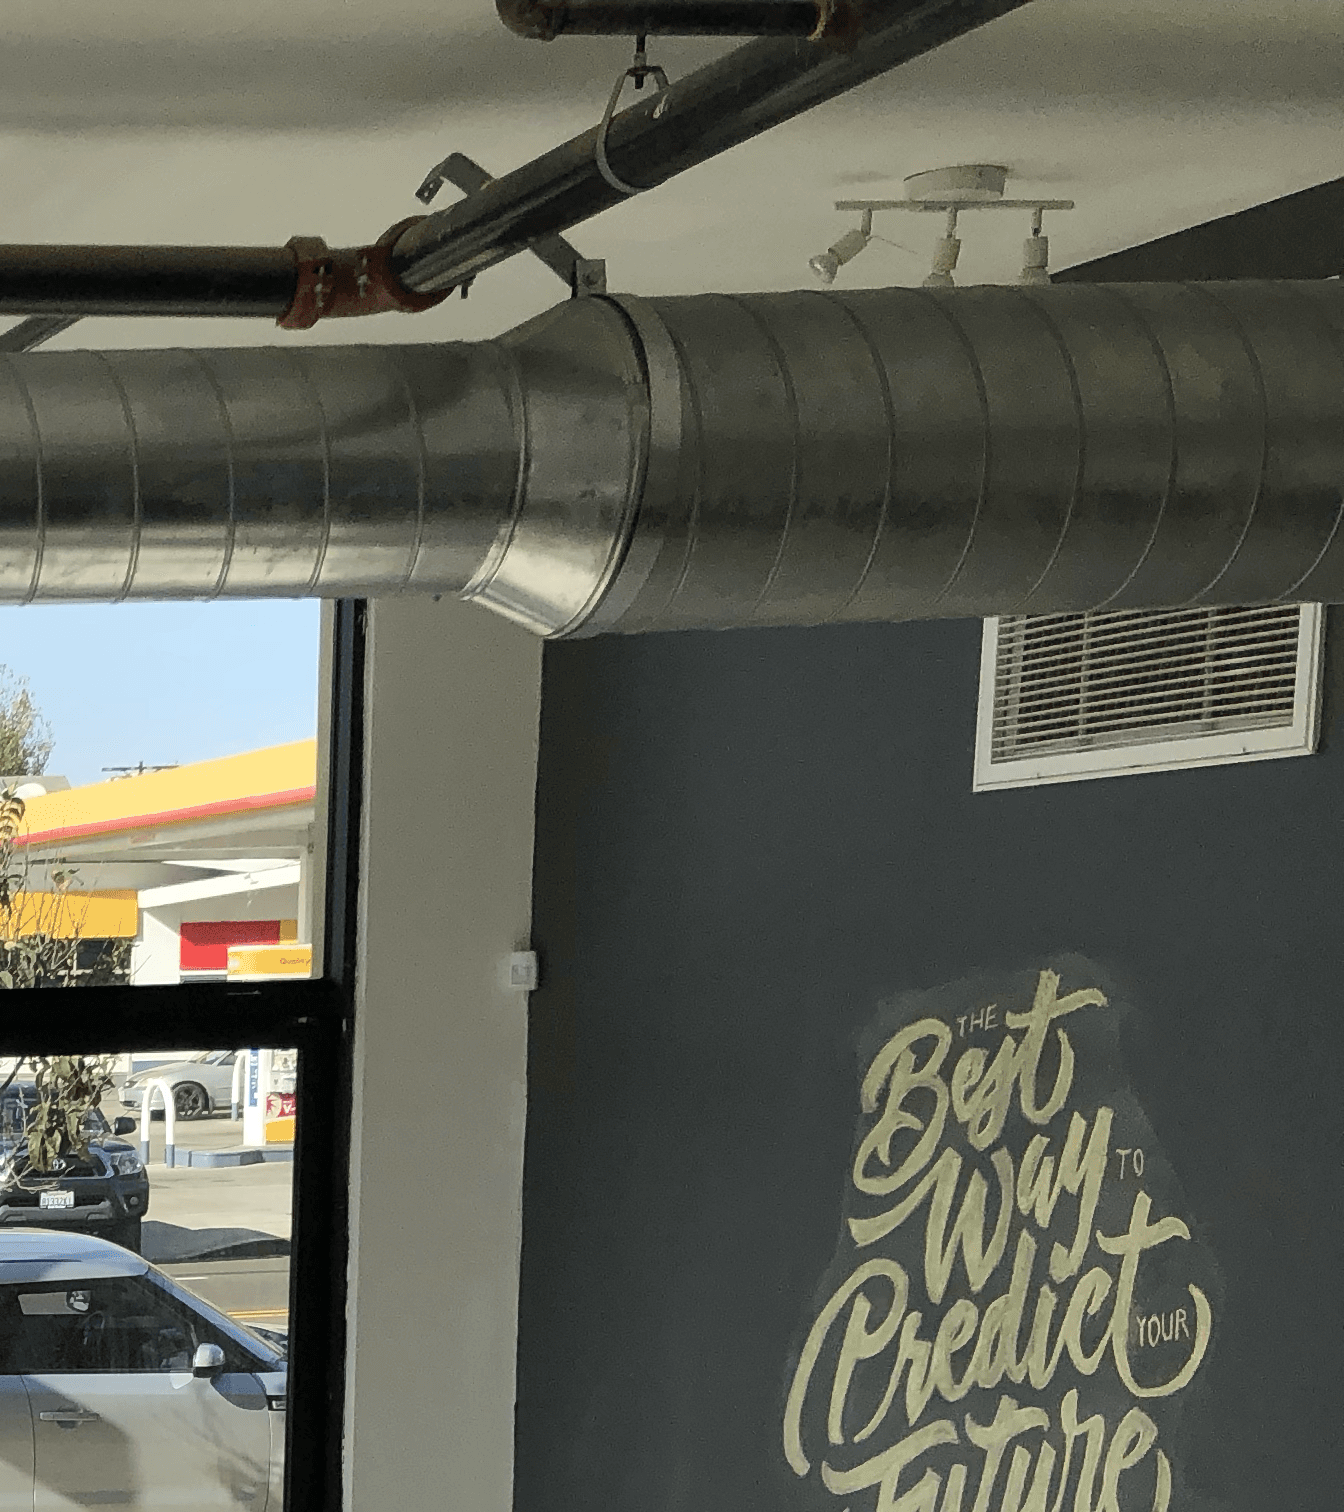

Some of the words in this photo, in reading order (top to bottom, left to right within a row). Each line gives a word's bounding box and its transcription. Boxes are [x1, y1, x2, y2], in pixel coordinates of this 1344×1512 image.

[853, 968, 1109, 1195] Best
[957, 1004, 999, 1037] THE
[848, 1107, 1113, 1304] Way
[1116, 1148, 1145, 1180] TO
[783, 1190, 1211, 1477] Predict
[1136, 1308, 1191, 1348] YOUR
